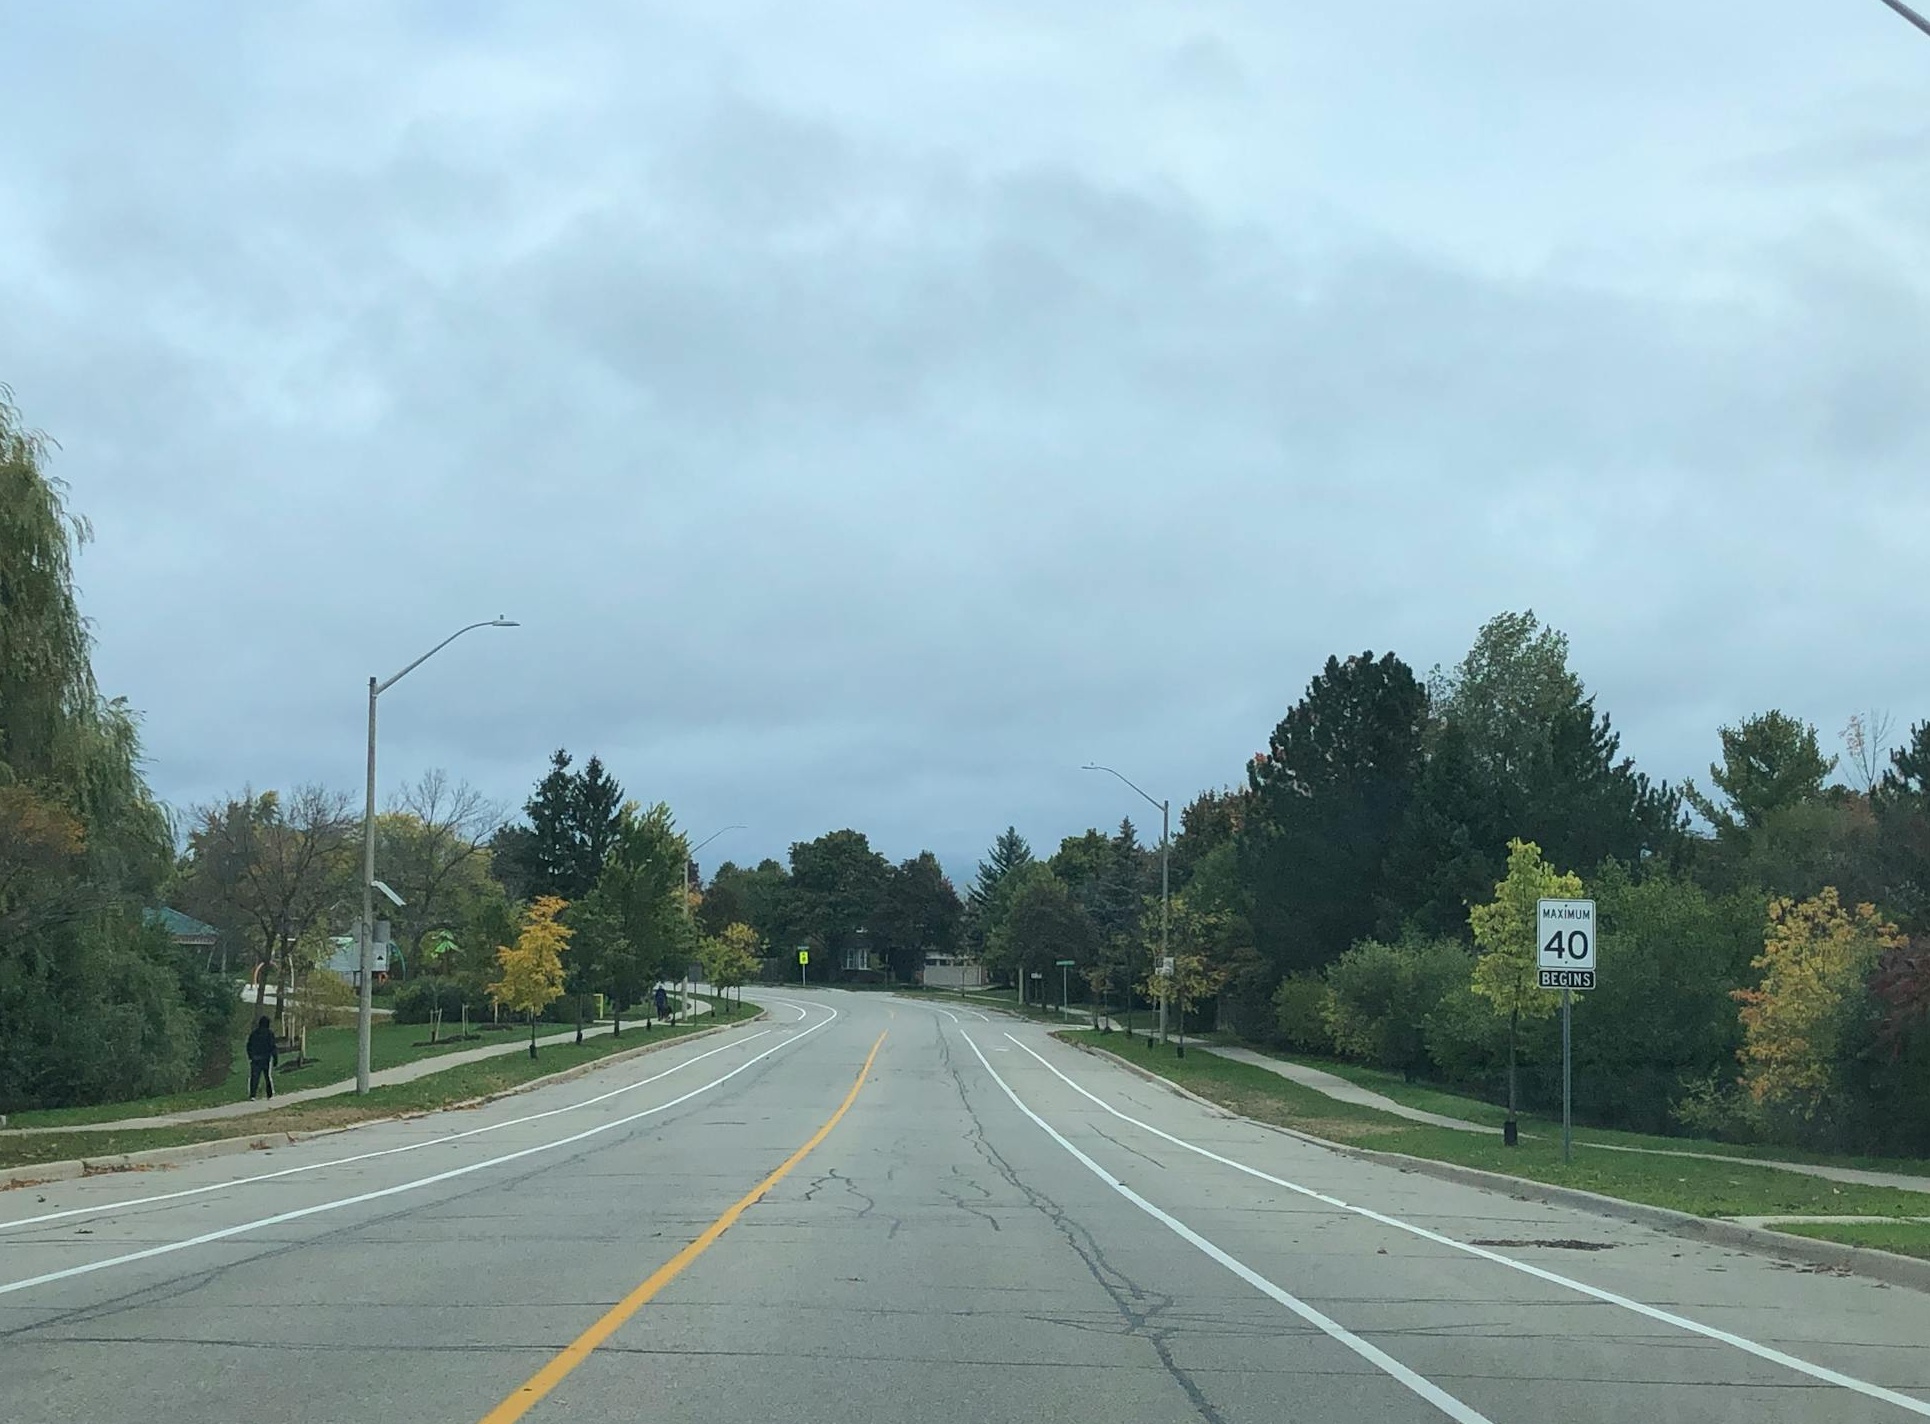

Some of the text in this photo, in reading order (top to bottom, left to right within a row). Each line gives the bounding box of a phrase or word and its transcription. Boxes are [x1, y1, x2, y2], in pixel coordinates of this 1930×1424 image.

[1543, 908, 1590, 920] MAXIMUM
[1544, 930, 1588, 960] 40
[1542, 972, 1591, 986] BEGINS
